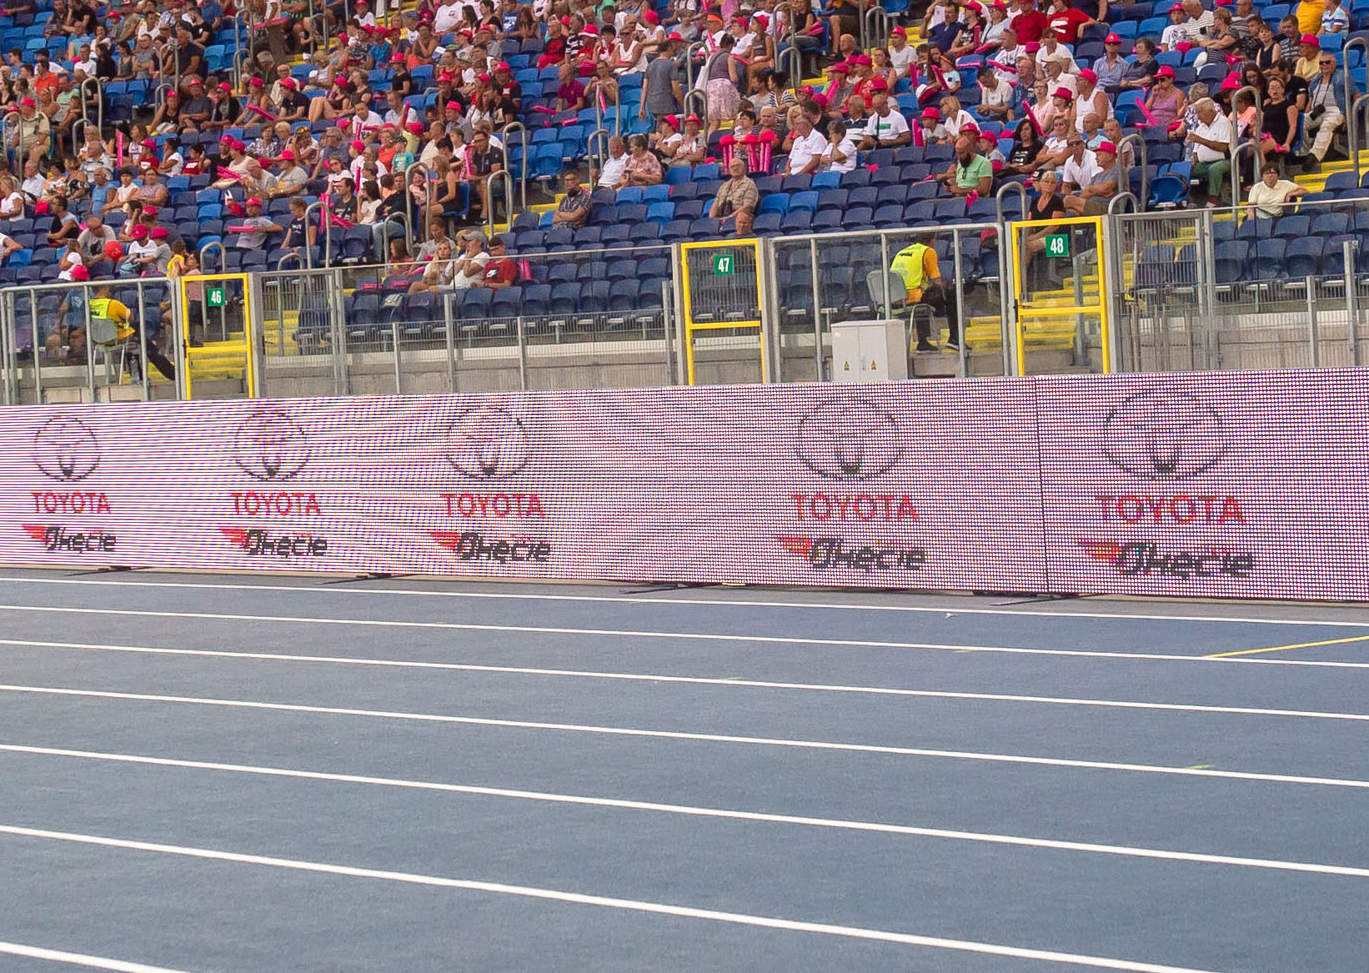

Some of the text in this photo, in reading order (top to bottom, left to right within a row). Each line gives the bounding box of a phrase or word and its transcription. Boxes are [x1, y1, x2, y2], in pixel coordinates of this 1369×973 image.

[1050, 238, 1064, 253] 48
[718, 258, 730, 272] 47
[211, 290, 221, 304] 46
[31, 492, 111, 514] TOYOTA
[230, 491, 321, 516] TOYOTA
[439, 493, 545, 518] TOYOTA
[792, 493, 920, 522] TOYOTA
[1096, 494, 1247, 527] TOYOTA
